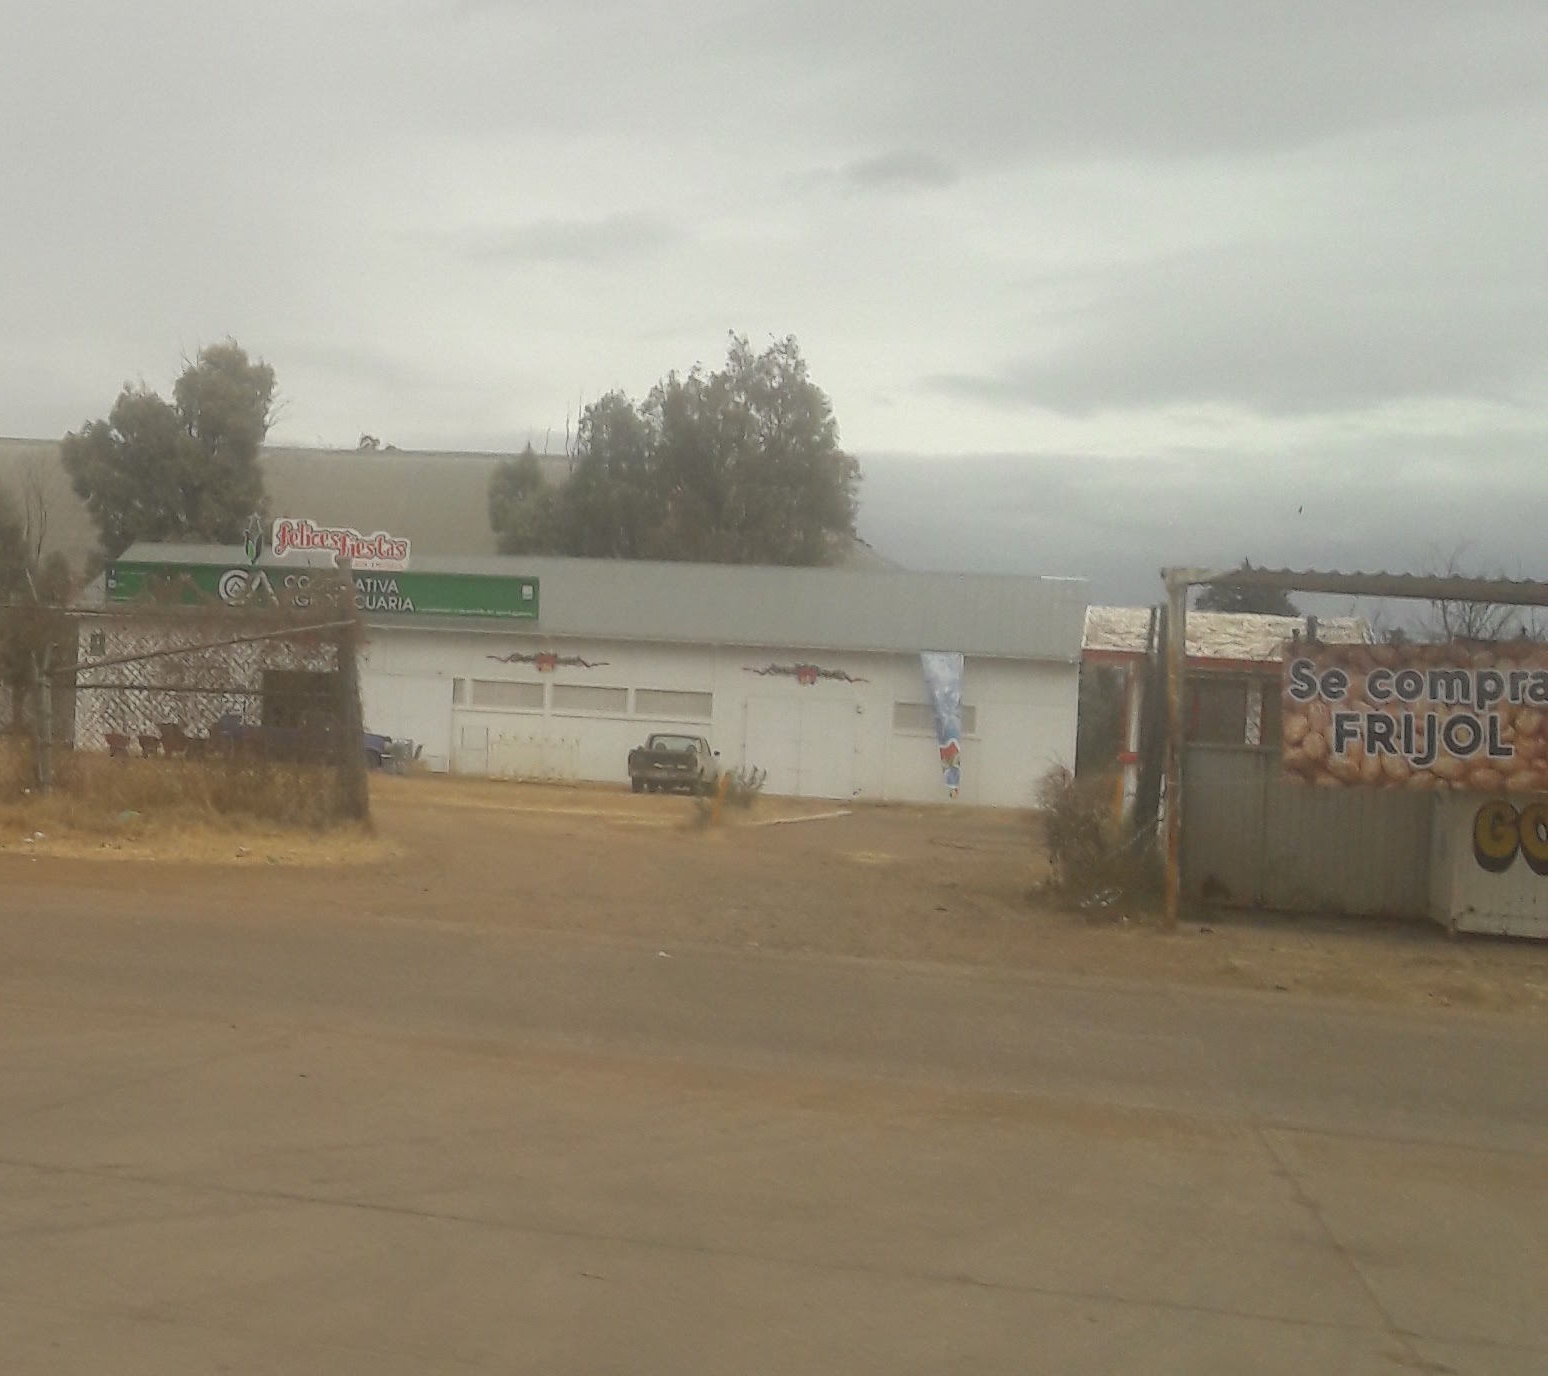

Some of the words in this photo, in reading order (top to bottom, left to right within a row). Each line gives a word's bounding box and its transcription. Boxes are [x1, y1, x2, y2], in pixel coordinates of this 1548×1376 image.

[1288, 658, 1350, 701] Se
[1367, 668, 1548, 712] compra
[1333, 712, 1514, 766] FRIJOL
